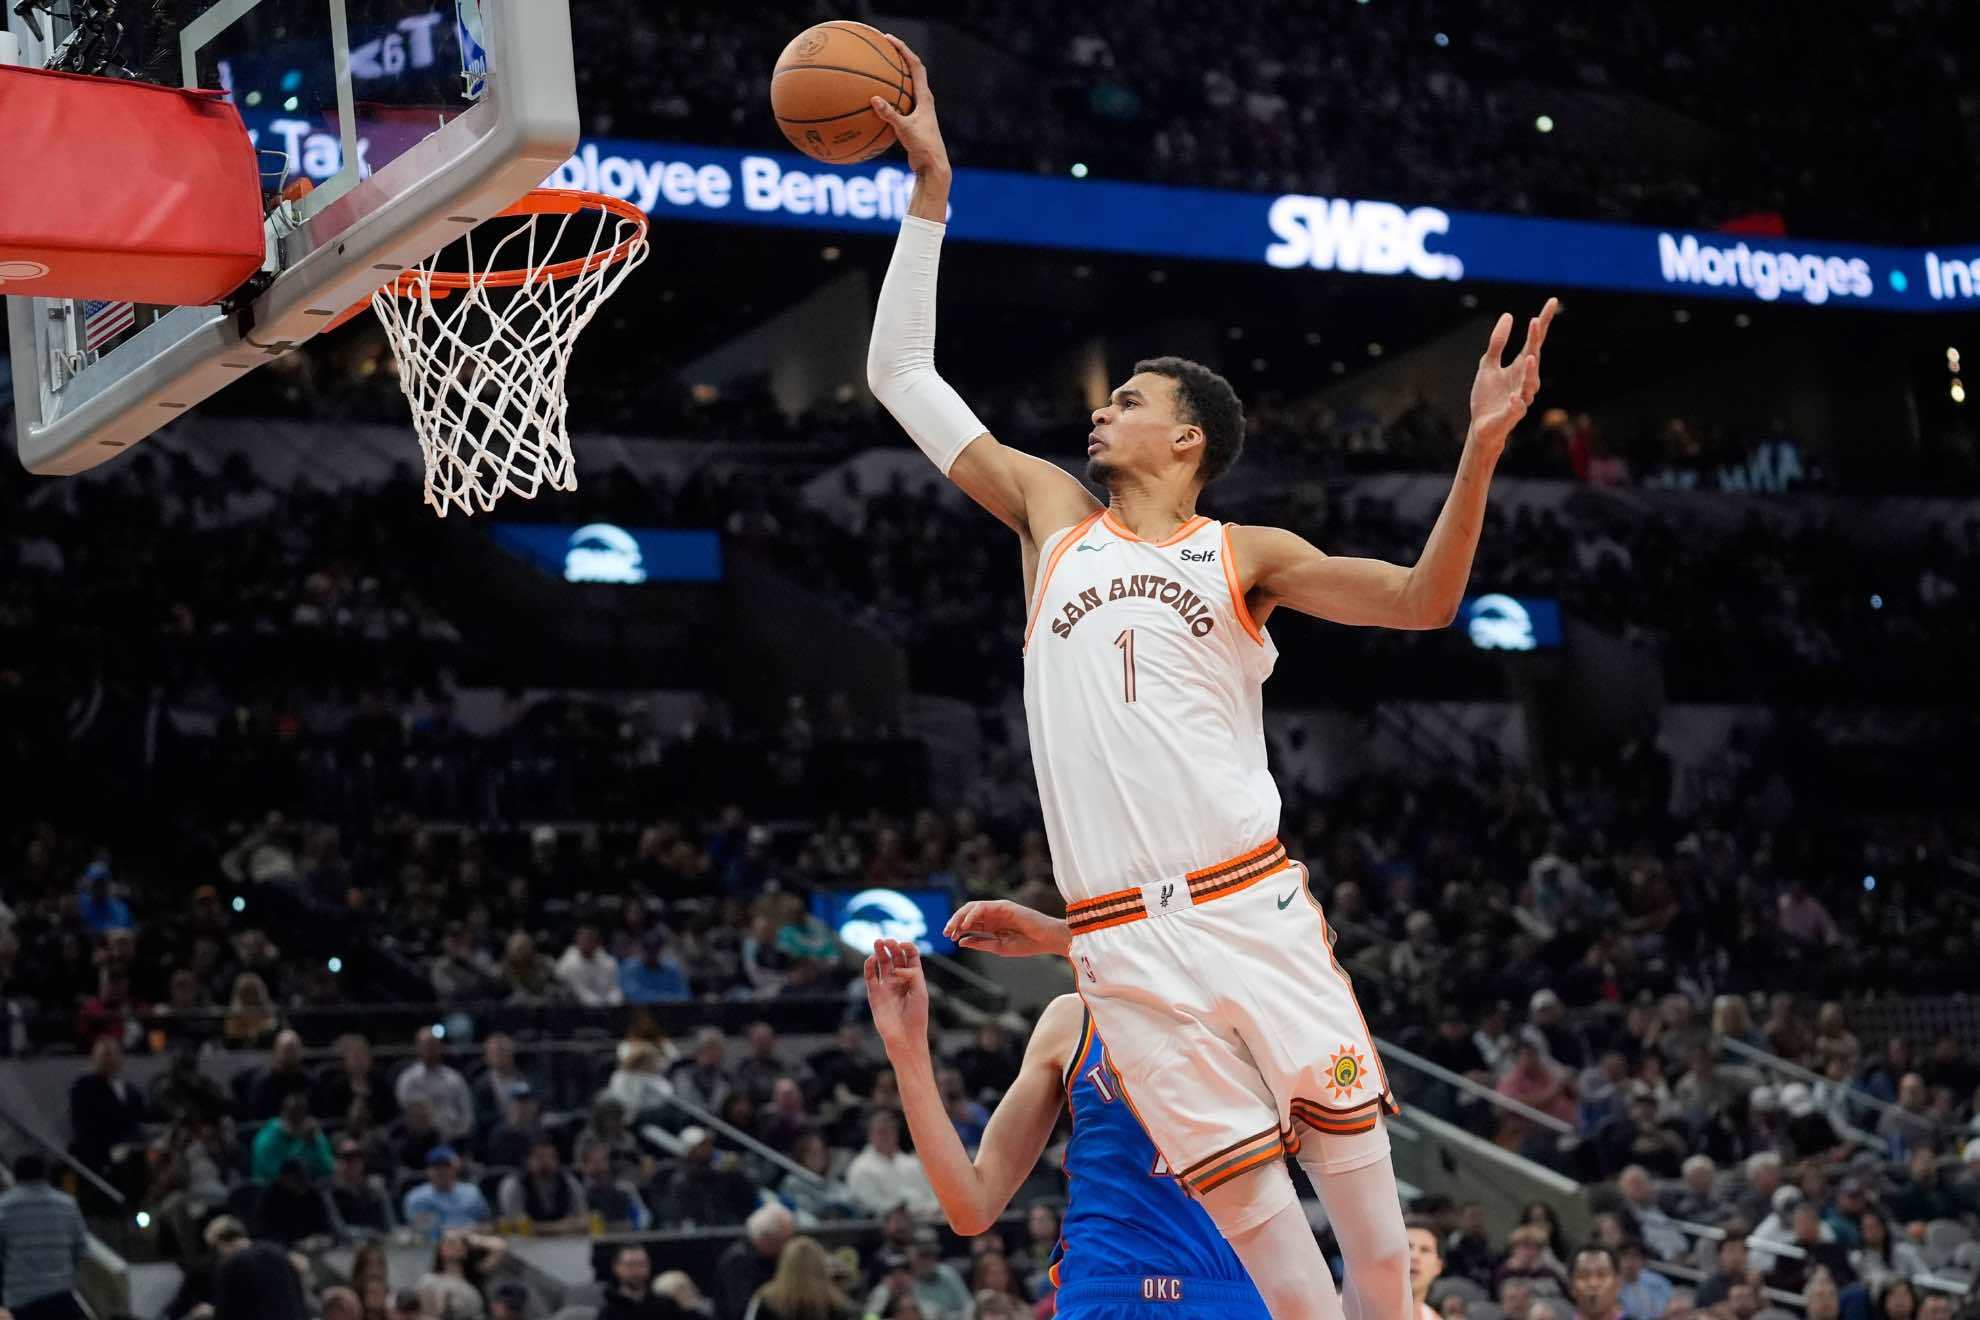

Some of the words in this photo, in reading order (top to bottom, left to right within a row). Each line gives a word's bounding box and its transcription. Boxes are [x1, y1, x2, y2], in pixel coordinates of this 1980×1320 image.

[740, 155, 952, 223] Benefi
[1657, 232, 1873, 304] Mortgages
[1051, 586, 1103, 639] SAN
[1108, 574, 1215, 638] ANTONIO
[1113, 628, 1137, 704] 1
[1143, 1277, 1181, 1300] OKC
